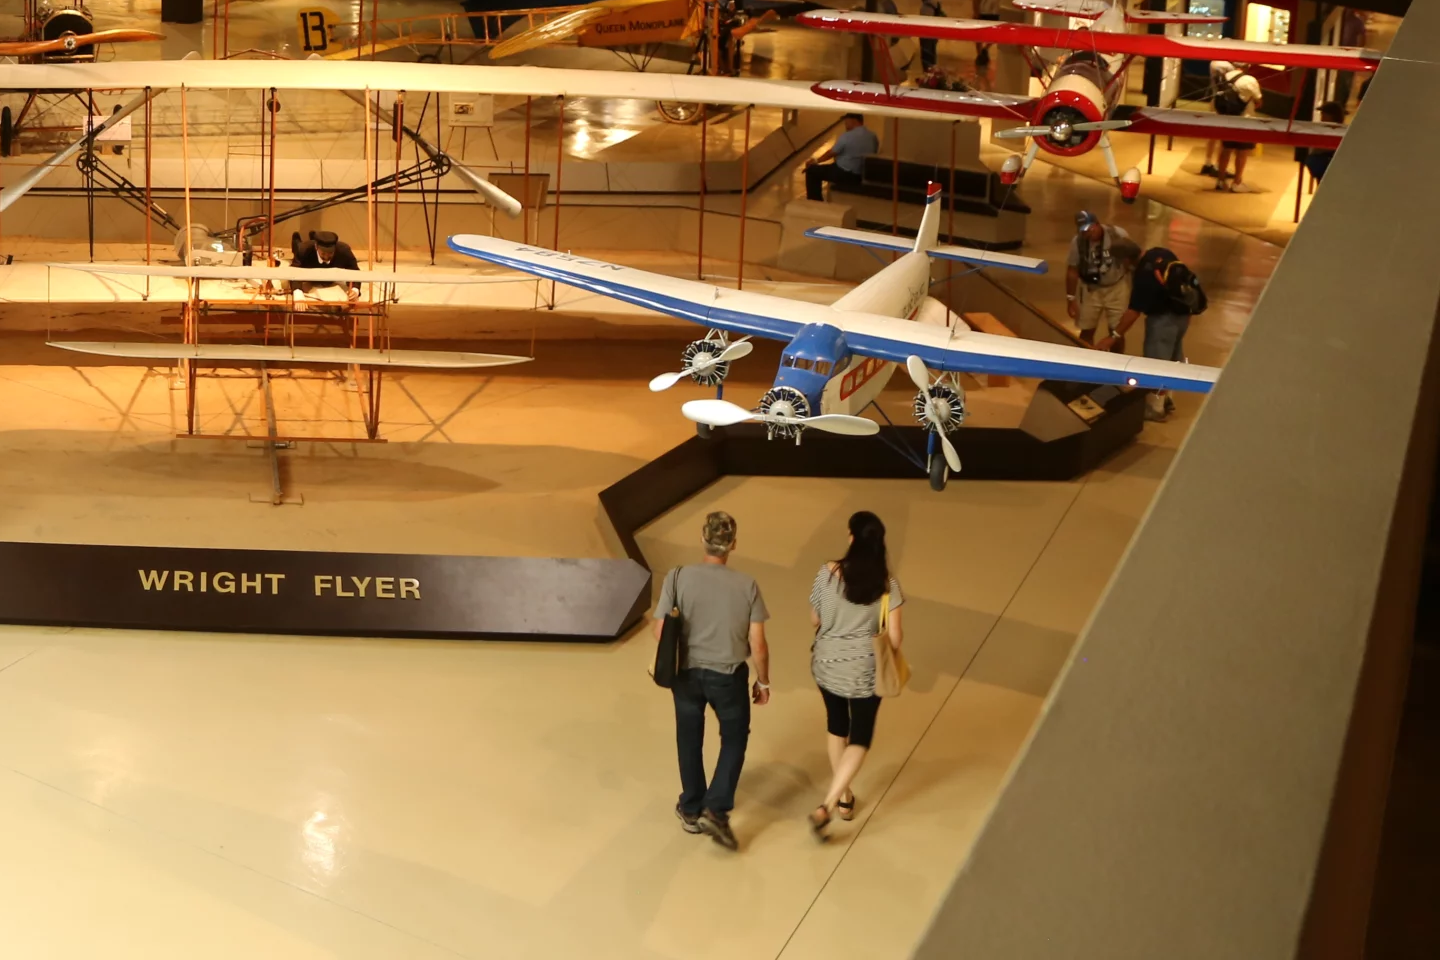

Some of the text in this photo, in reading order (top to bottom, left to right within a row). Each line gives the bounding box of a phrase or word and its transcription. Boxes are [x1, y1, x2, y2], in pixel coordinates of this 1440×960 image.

[300, 11, 328, 52] 13
[138, 569, 421, 600] WRIGHT FLYER
